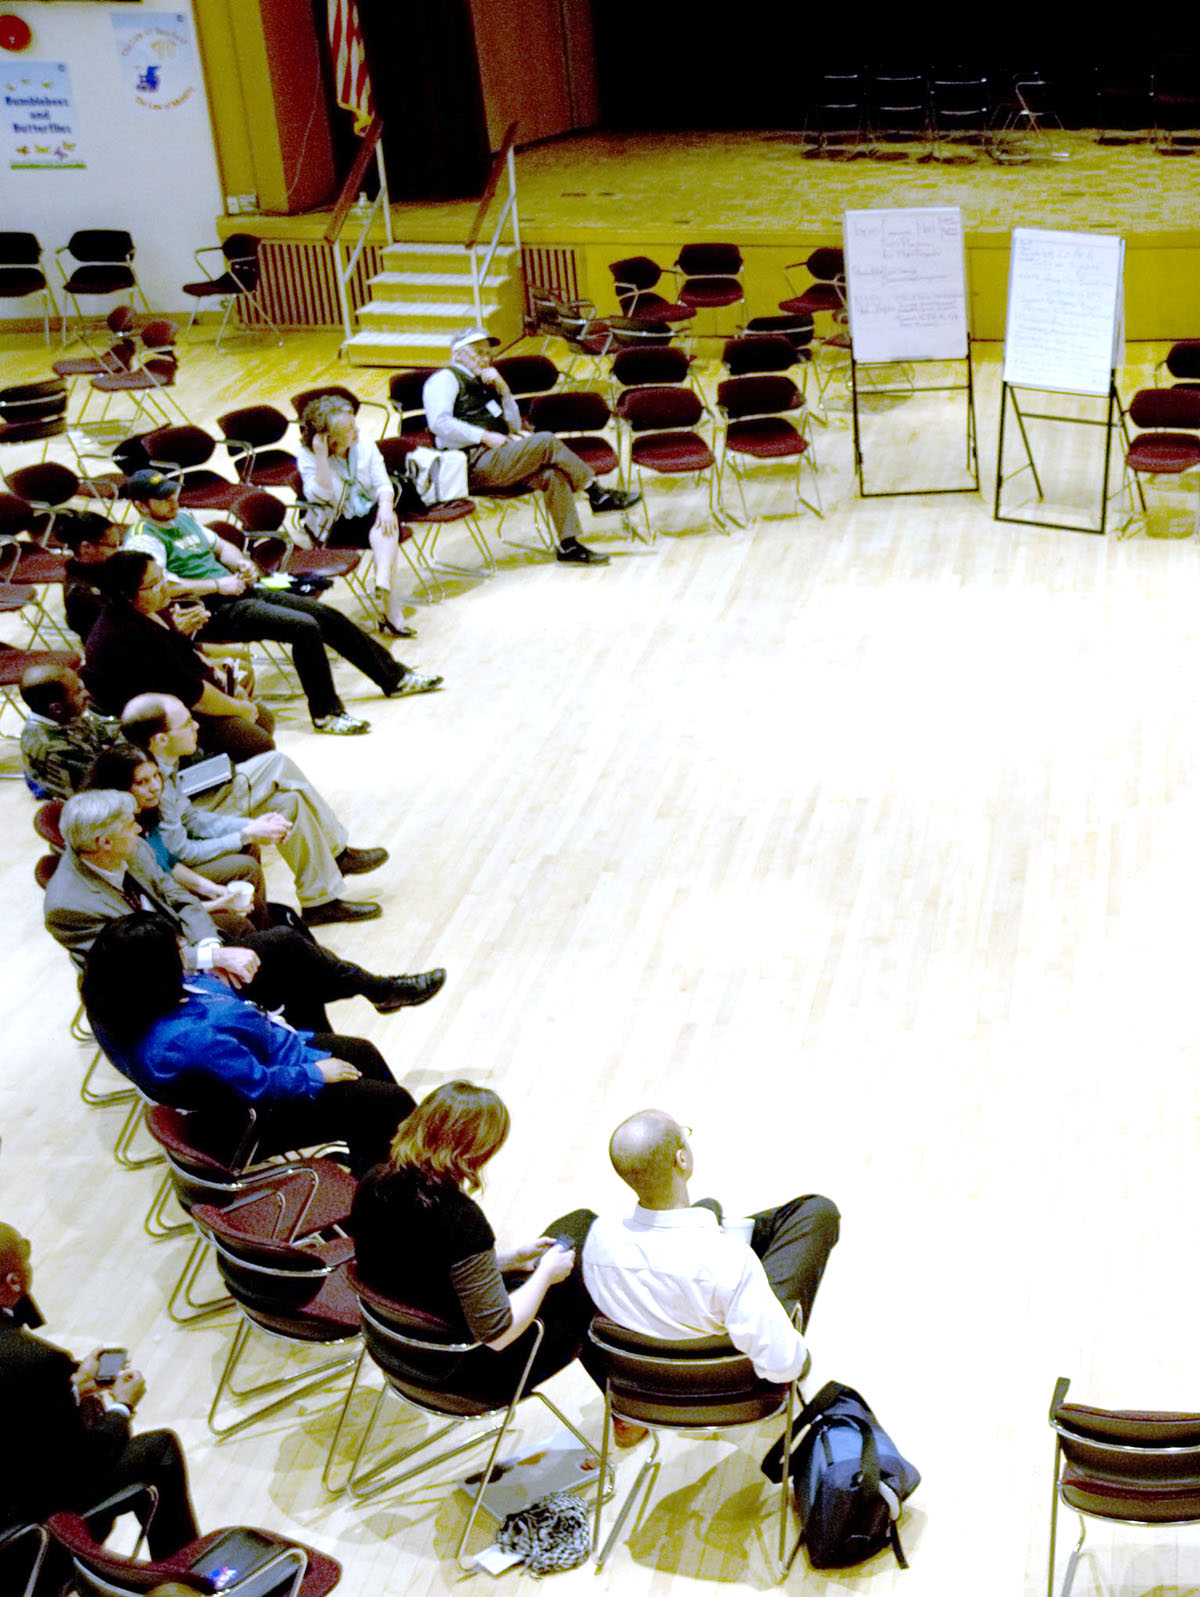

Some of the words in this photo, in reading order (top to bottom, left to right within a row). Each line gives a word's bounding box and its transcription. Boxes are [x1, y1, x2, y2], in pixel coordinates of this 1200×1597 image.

[5, 96, 69, 106] Bumblebees
[30, 110, 50, 120] and
[13, 123, 72, 133] Butterflies
